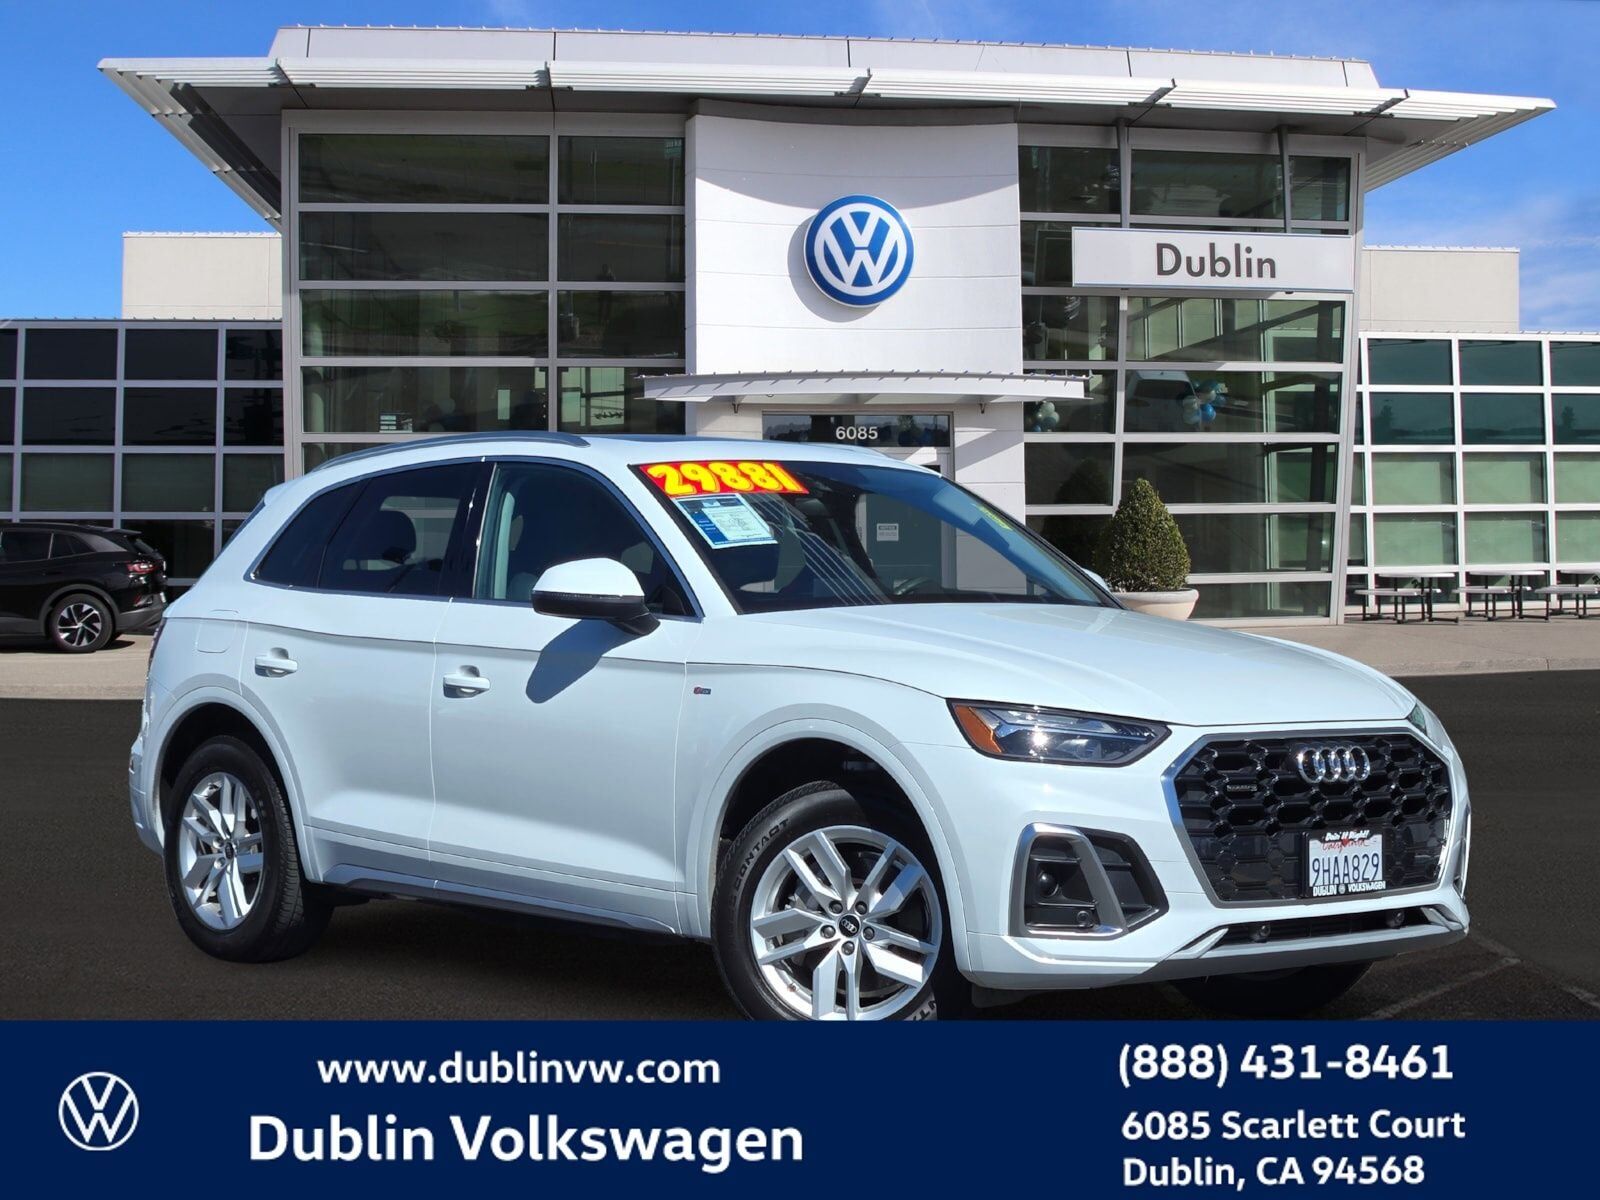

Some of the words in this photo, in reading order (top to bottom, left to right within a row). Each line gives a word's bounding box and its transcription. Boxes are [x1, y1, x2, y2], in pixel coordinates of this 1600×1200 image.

[1156, 242, 1276, 279] Dublin
[835, 426, 878, 440] 6085
[647, 462, 802, 495] 29881
[1312, 853, 1380, 886] 9HAA829
[1312, 885, 1337, 896] DUBLIN
[1348, 881, 1386, 892] VOLKSWAGEN
